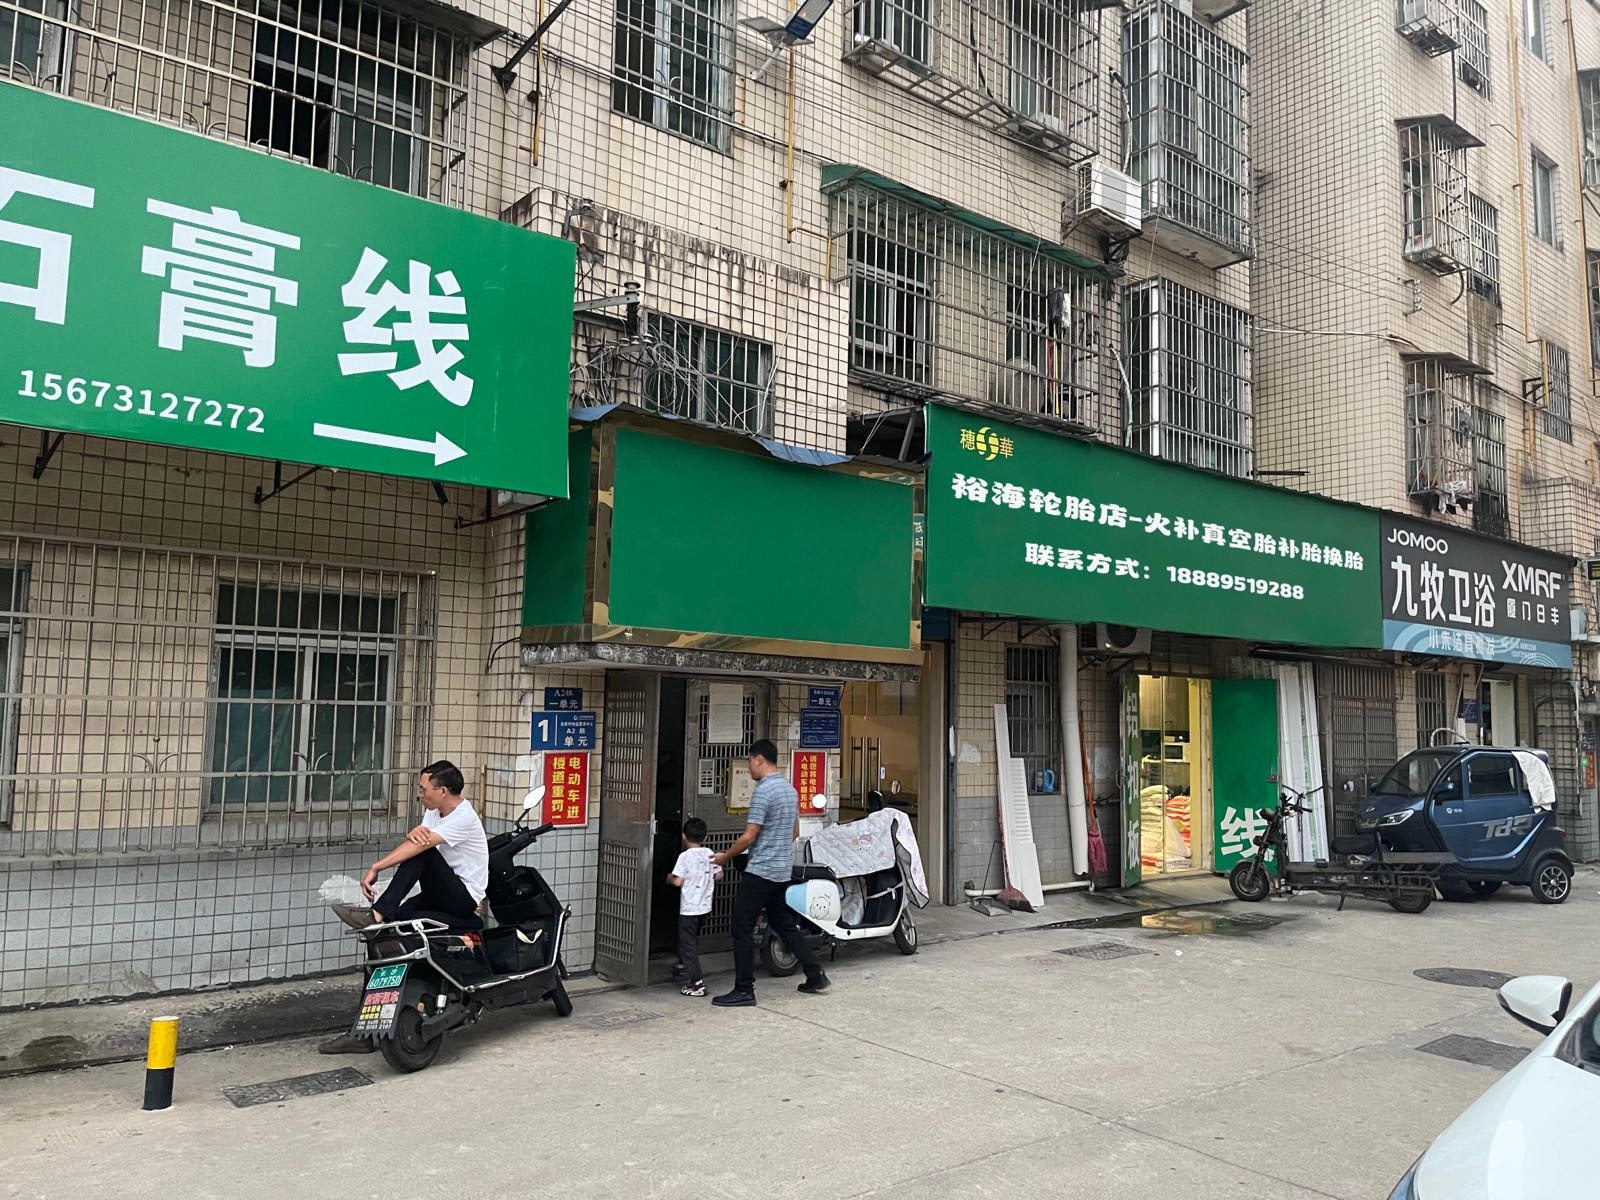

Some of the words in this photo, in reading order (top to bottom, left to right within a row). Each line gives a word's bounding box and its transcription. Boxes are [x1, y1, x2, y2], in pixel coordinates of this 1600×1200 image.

[0, 166, 475, 407] 石膏线
[18, 369, 266, 434] 15673127272
[952, 473, 1364, 571] 裕海轮胎店-火补真空胎补胎换胎
[1387, 528, 1449, 554] JOMOO
[1166, 565, 1305, 600] 18889519288
[1391, 555, 1496, 628] 九牧卫浴
[1501, 560, 1562, 599] XMRF
[549, 699, 579, 710] 一单元
[538, 719, 549, 742] 1
[563, 735, 588, 748] 单元
[567, 756, 581, 819] 电动车进
[1220, 806, 1275, 863] 线
